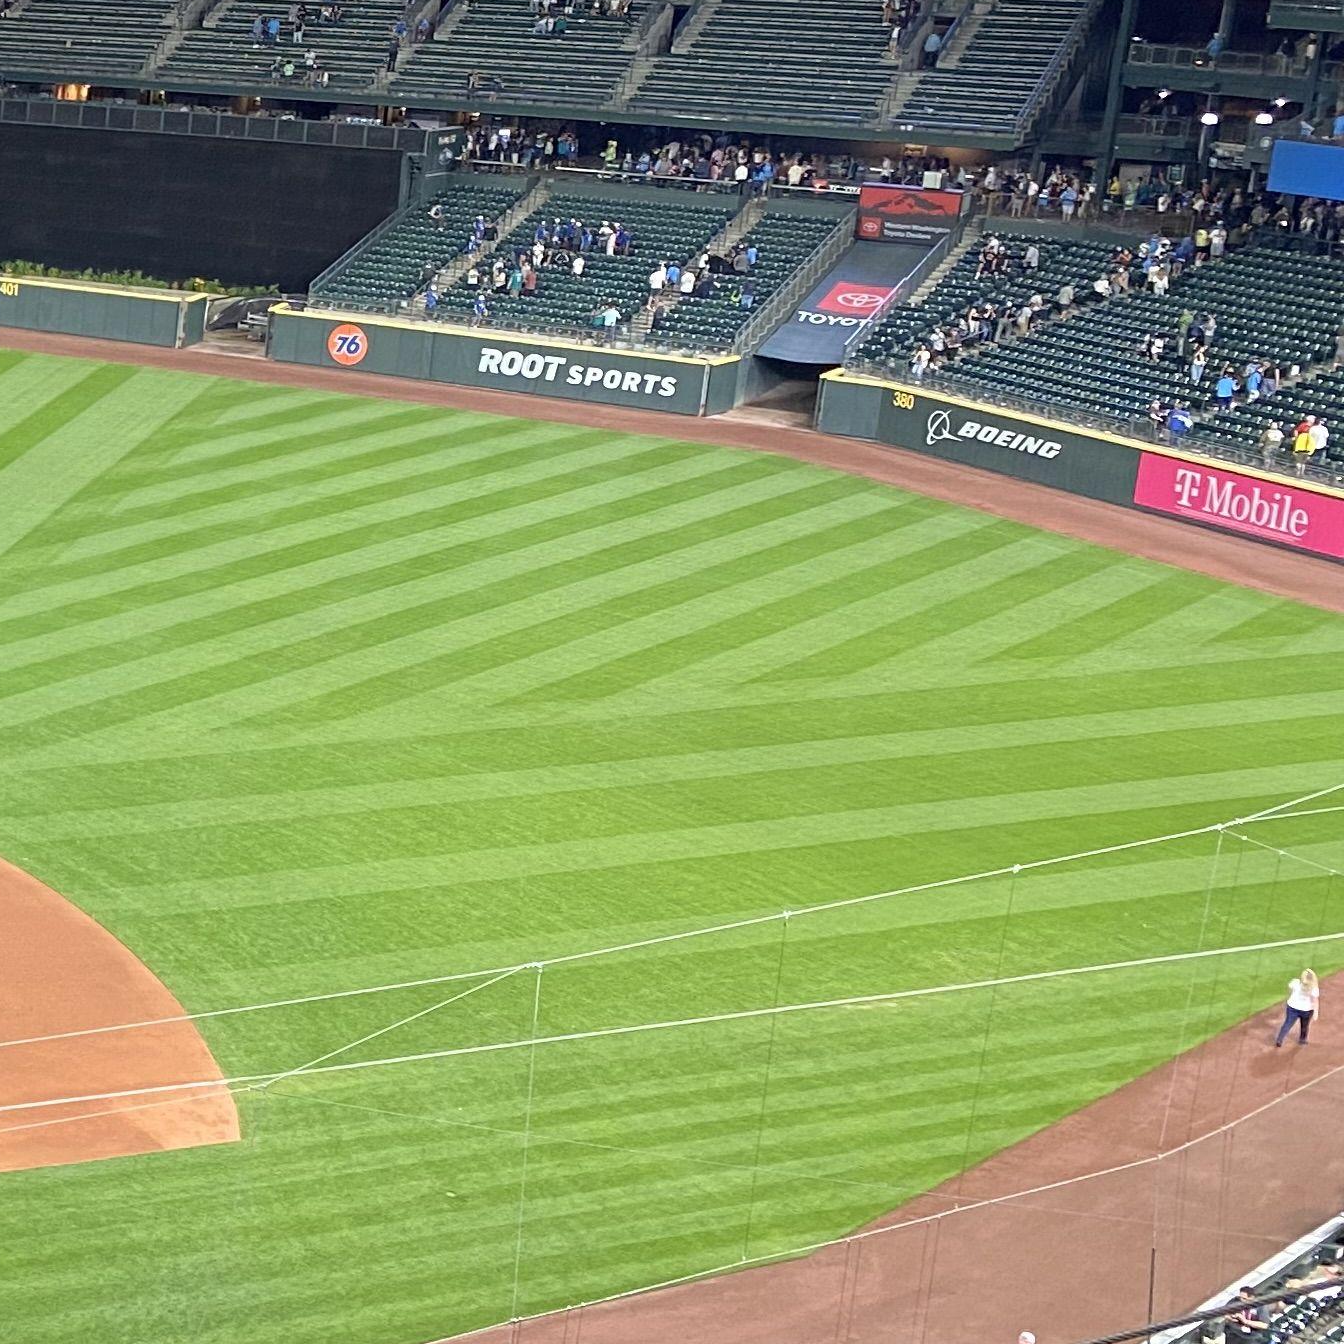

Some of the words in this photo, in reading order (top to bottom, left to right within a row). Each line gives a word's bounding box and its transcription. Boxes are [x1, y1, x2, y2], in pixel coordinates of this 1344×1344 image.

[0, 282, 18, 296] 401
[798, 311, 872, 329] TOYOT
[334, 334, 361, 355] 76
[477, 347, 567, 381] ROOT
[565, 364, 678, 397] SPORTS
[892, 391, 915, 410] 380
[956, 420, 1063, 459] BOEING
